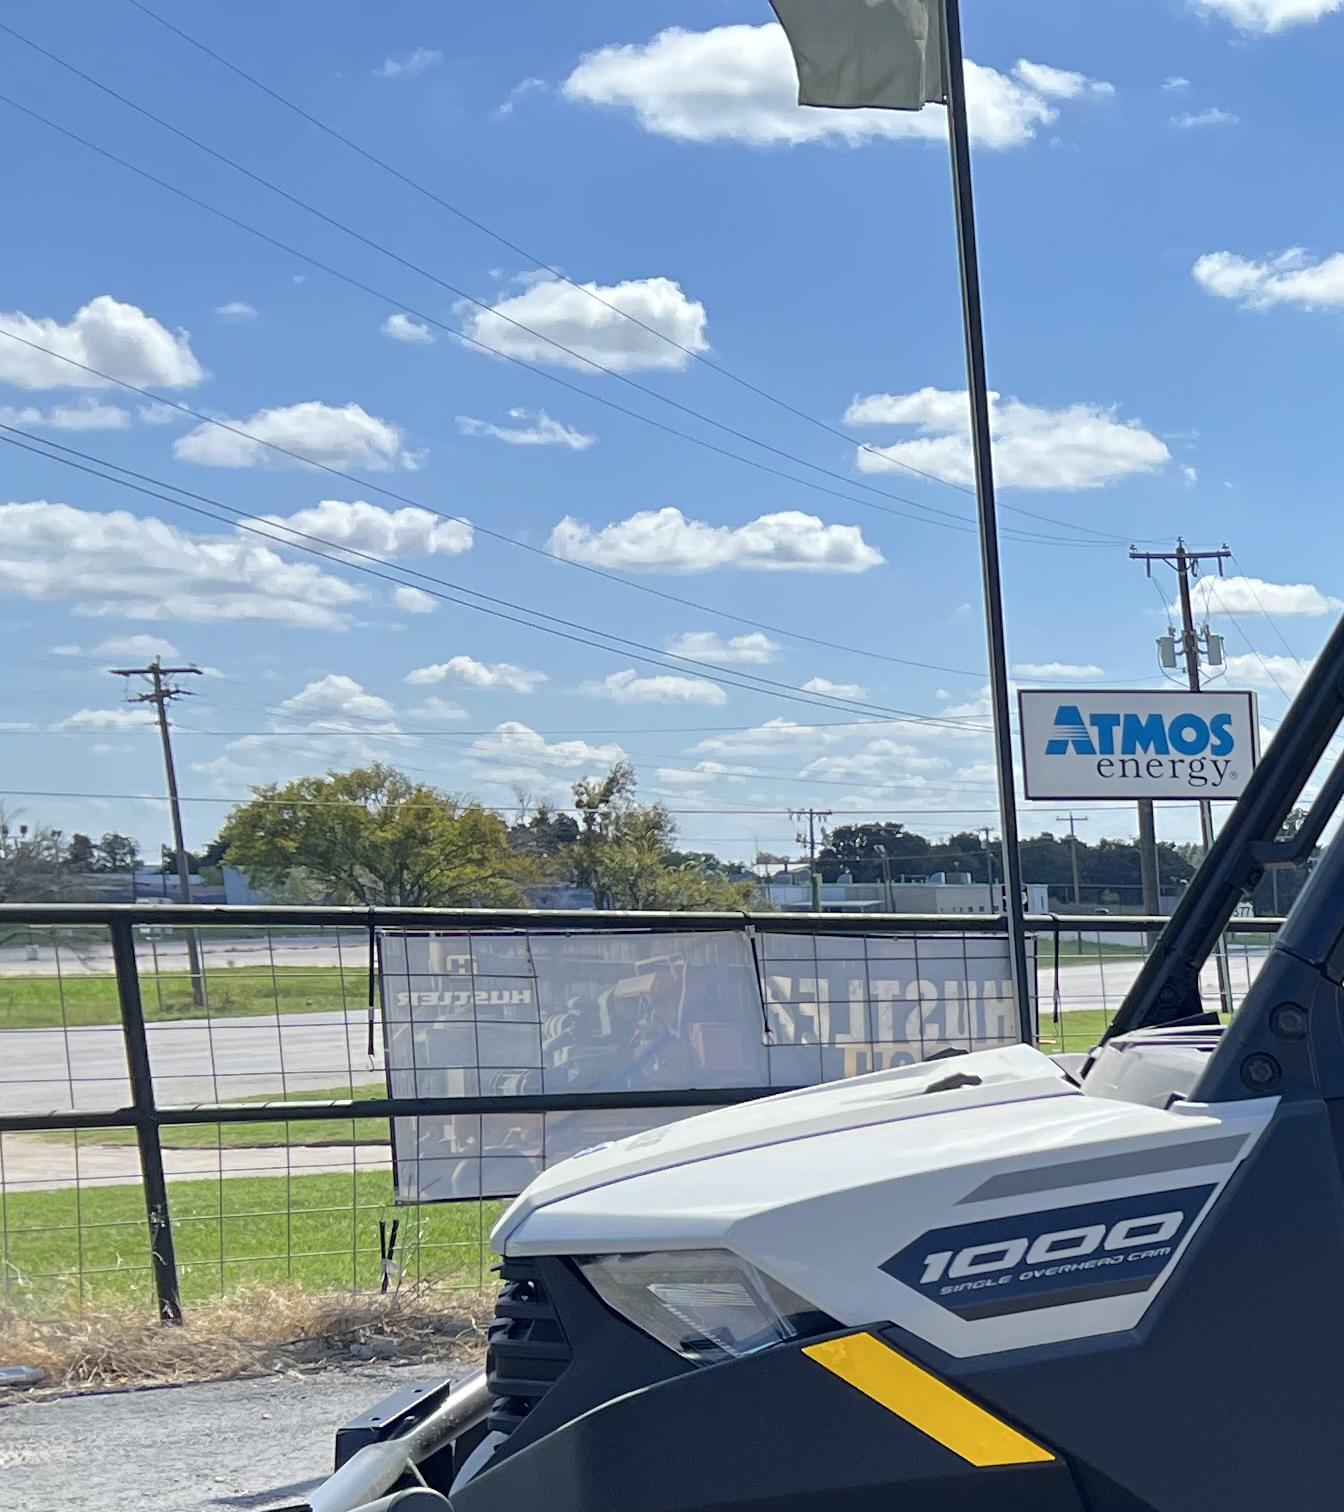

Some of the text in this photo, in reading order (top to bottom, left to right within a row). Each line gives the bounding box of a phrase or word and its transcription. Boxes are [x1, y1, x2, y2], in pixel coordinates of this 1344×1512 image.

[1045, 705, 1234, 756] ATMOS
[1097, 757, 1231, 787] energy
[919, 1211, 1183, 1284] 1000
[939, 1246, 1171, 1296] SINGLE OVERHEAD CAM
